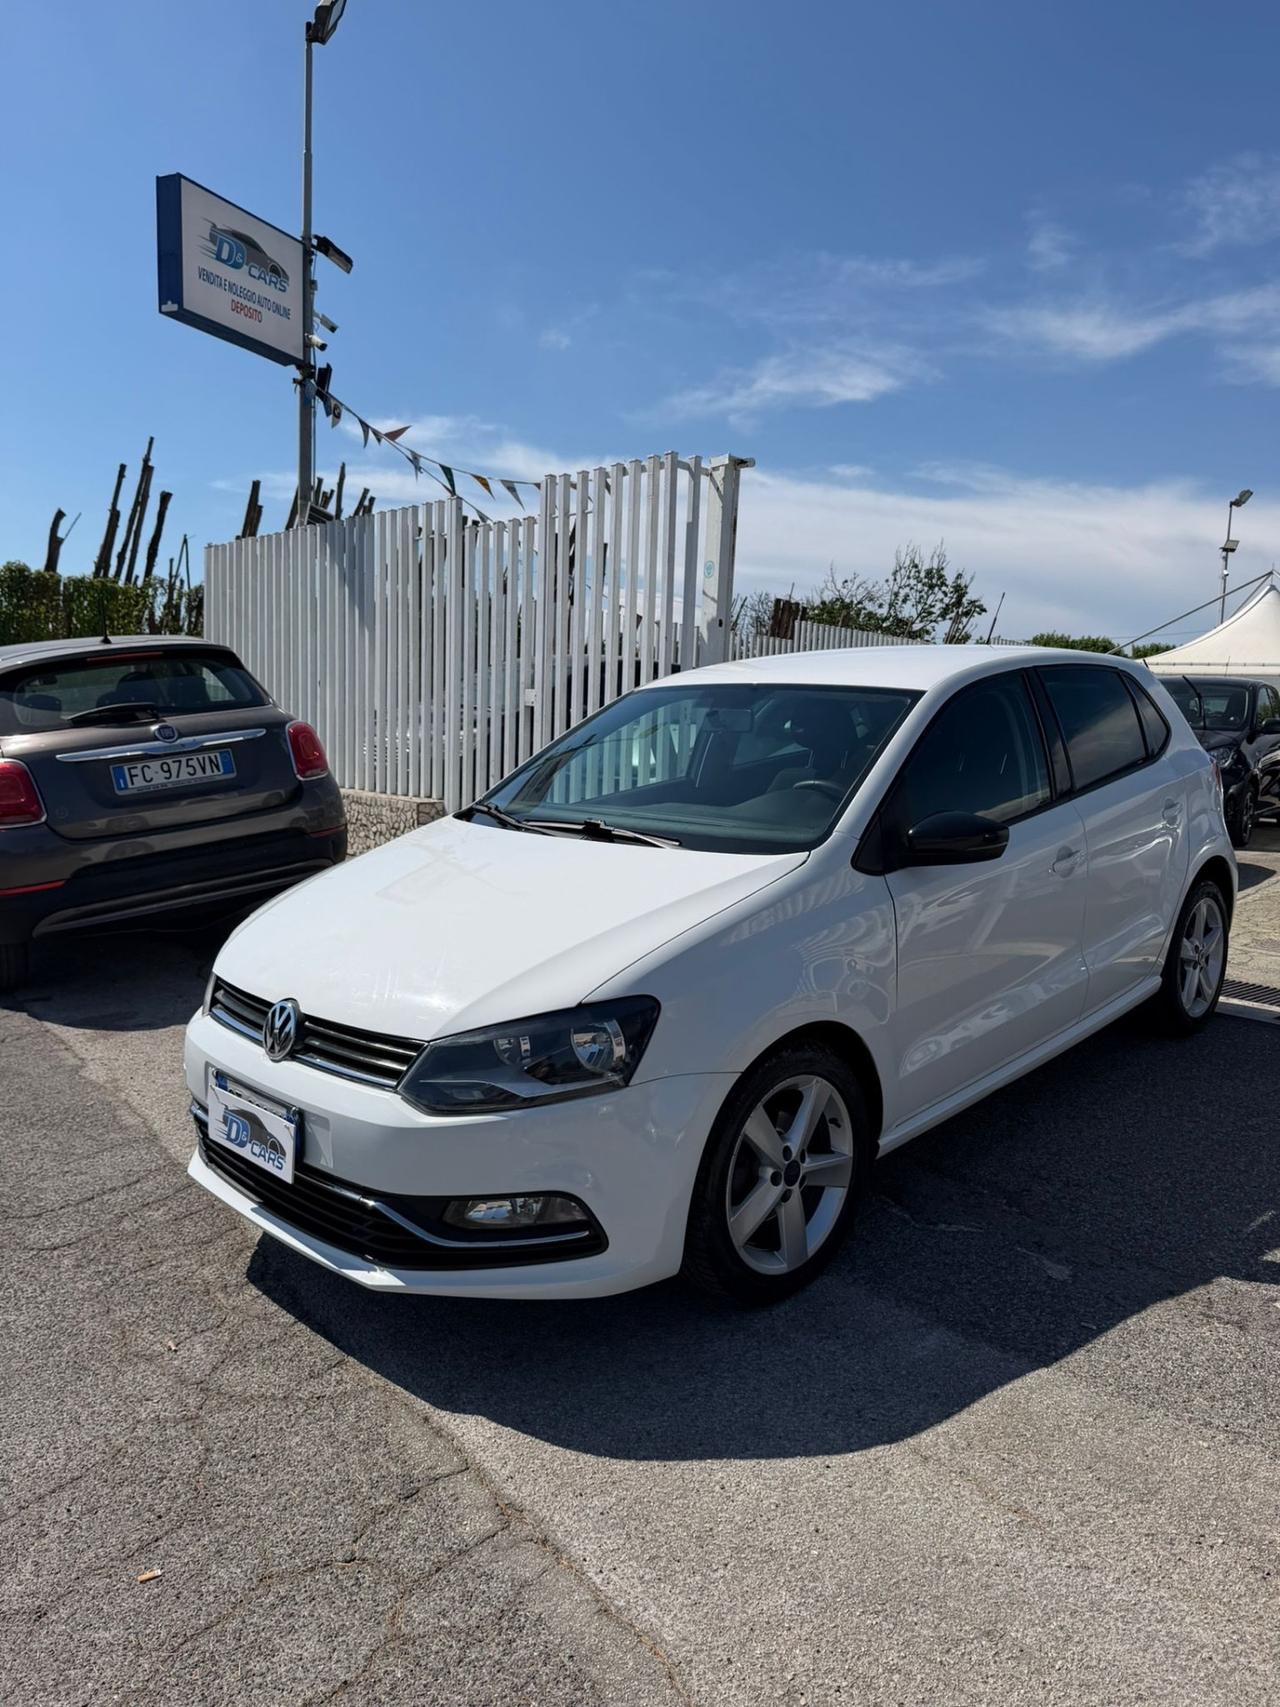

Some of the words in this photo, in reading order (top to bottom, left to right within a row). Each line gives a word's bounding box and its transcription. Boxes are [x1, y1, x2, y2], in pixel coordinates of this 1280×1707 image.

[198, 266, 223, 289] VENDITA
[224, 279, 228, 292] E
[228, 281, 256, 304] NOLEGGIO
[257, 294, 272, 311] AUTO
[272, 301, 291, 320] ONLINE
[248, 262, 289, 293] CARS
[231, 299, 262, 323] DEPOSITO
[127, 764, 154, 786] FC
[160, 754, 221, 780] 975VN
[250, 1140, 284, 1171] CARS
